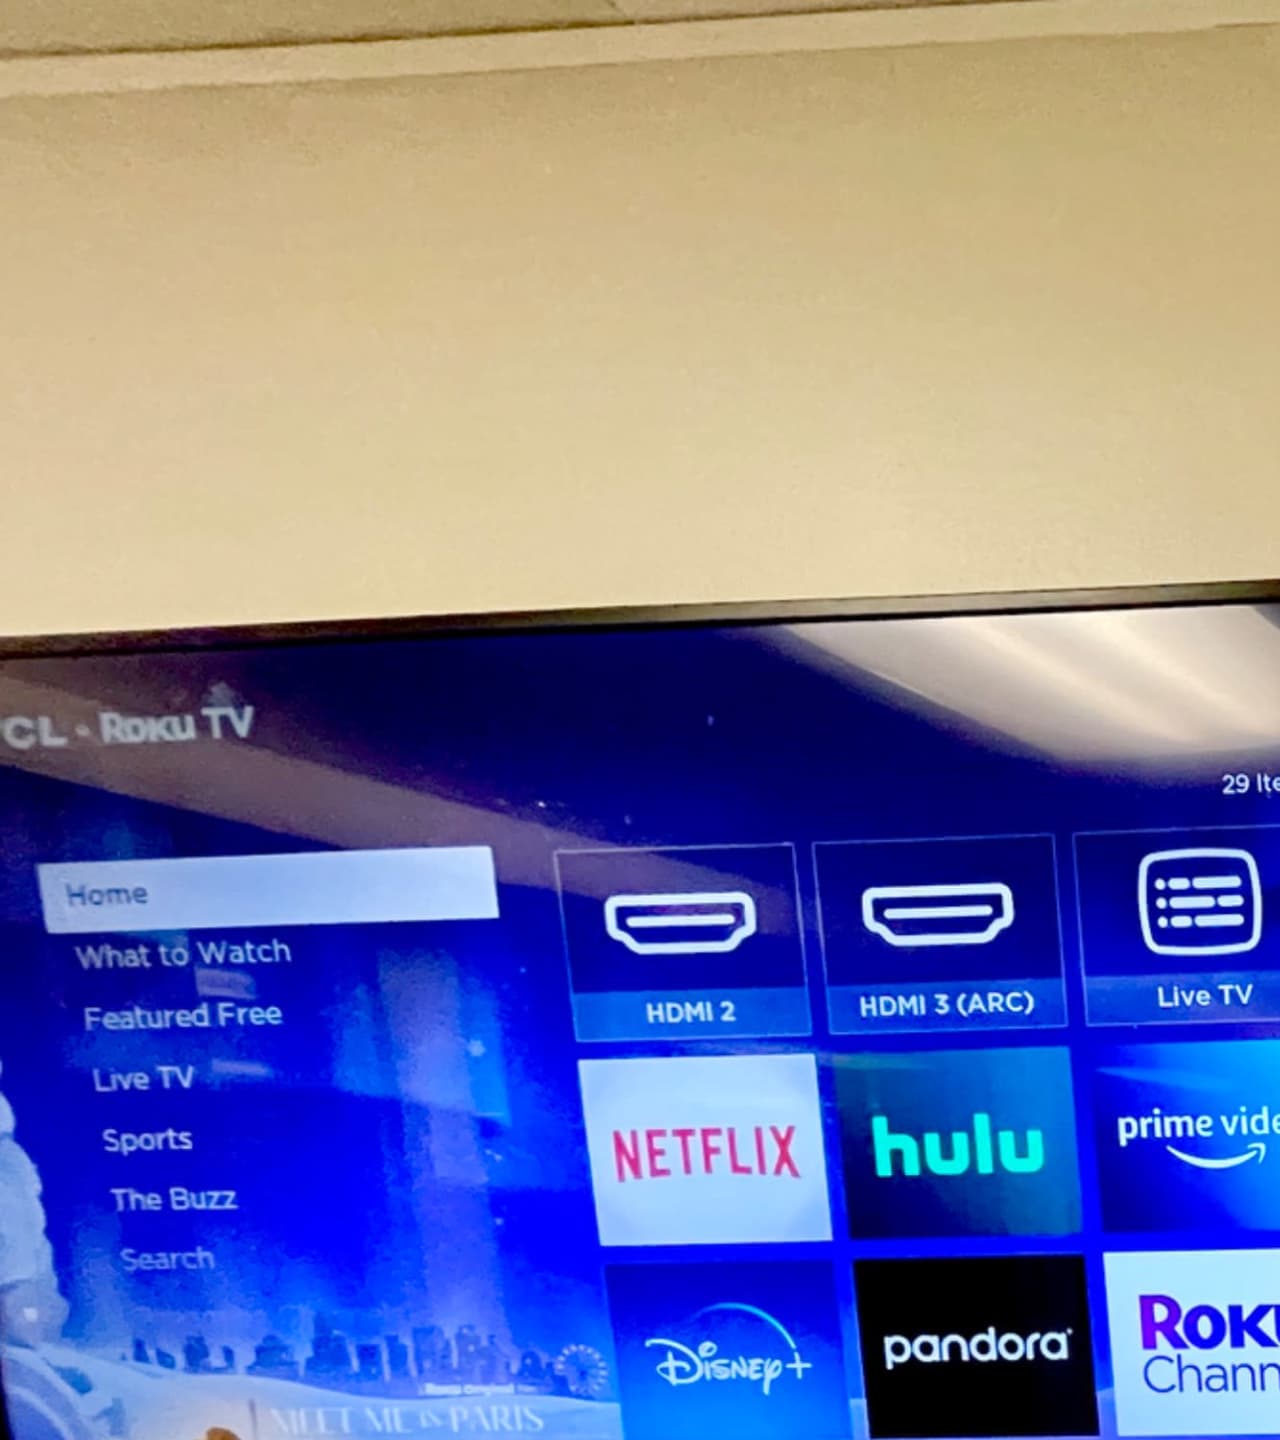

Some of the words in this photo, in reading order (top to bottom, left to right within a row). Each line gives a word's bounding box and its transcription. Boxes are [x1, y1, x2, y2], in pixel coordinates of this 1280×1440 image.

[0, 715, 68, 749] CL
[100, 711, 196, 744] Roku
[201, 705, 253, 739] TV
[1221, 772, 1251, 796] 29
[66, 882, 149, 907] Home
[75, 944, 152, 969] What
[160, 945, 189, 967] to
[197, 938, 292, 965] Watch
[859, 992, 926, 1020] HDMI
[934, 992, 951, 1016] 3
[956, 987, 1036, 1019] (ARC)
[1157, 983, 1212, 1009] Live
[1216, 983, 1254, 1005] TV
[84, 1004, 209, 1031] Featured
[217, 1001, 283, 1027] Free
[646, 1002, 714, 1025] HDMI
[721, 1001, 736, 1022] 2
[93, 1067, 149, 1092] Live
[157, 1065, 194, 1089] TV
[103, 1127, 193, 1157] Sports
[1117, 1109, 1213, 1149] prime
[612, 1125, 801, 1183] NETFLIX
[872, 1113, 1044, 1178] hulu
[111, 1188, 163, 1212] The
[171, 1188, 238, 1211] Buzz
[120, 1247, 215, 1273] Search
[883, 1326, 1073, 1370] pandora
[365, 1407, 412, 1433] ME
[452, 1405, 544, 1433] PARIS
